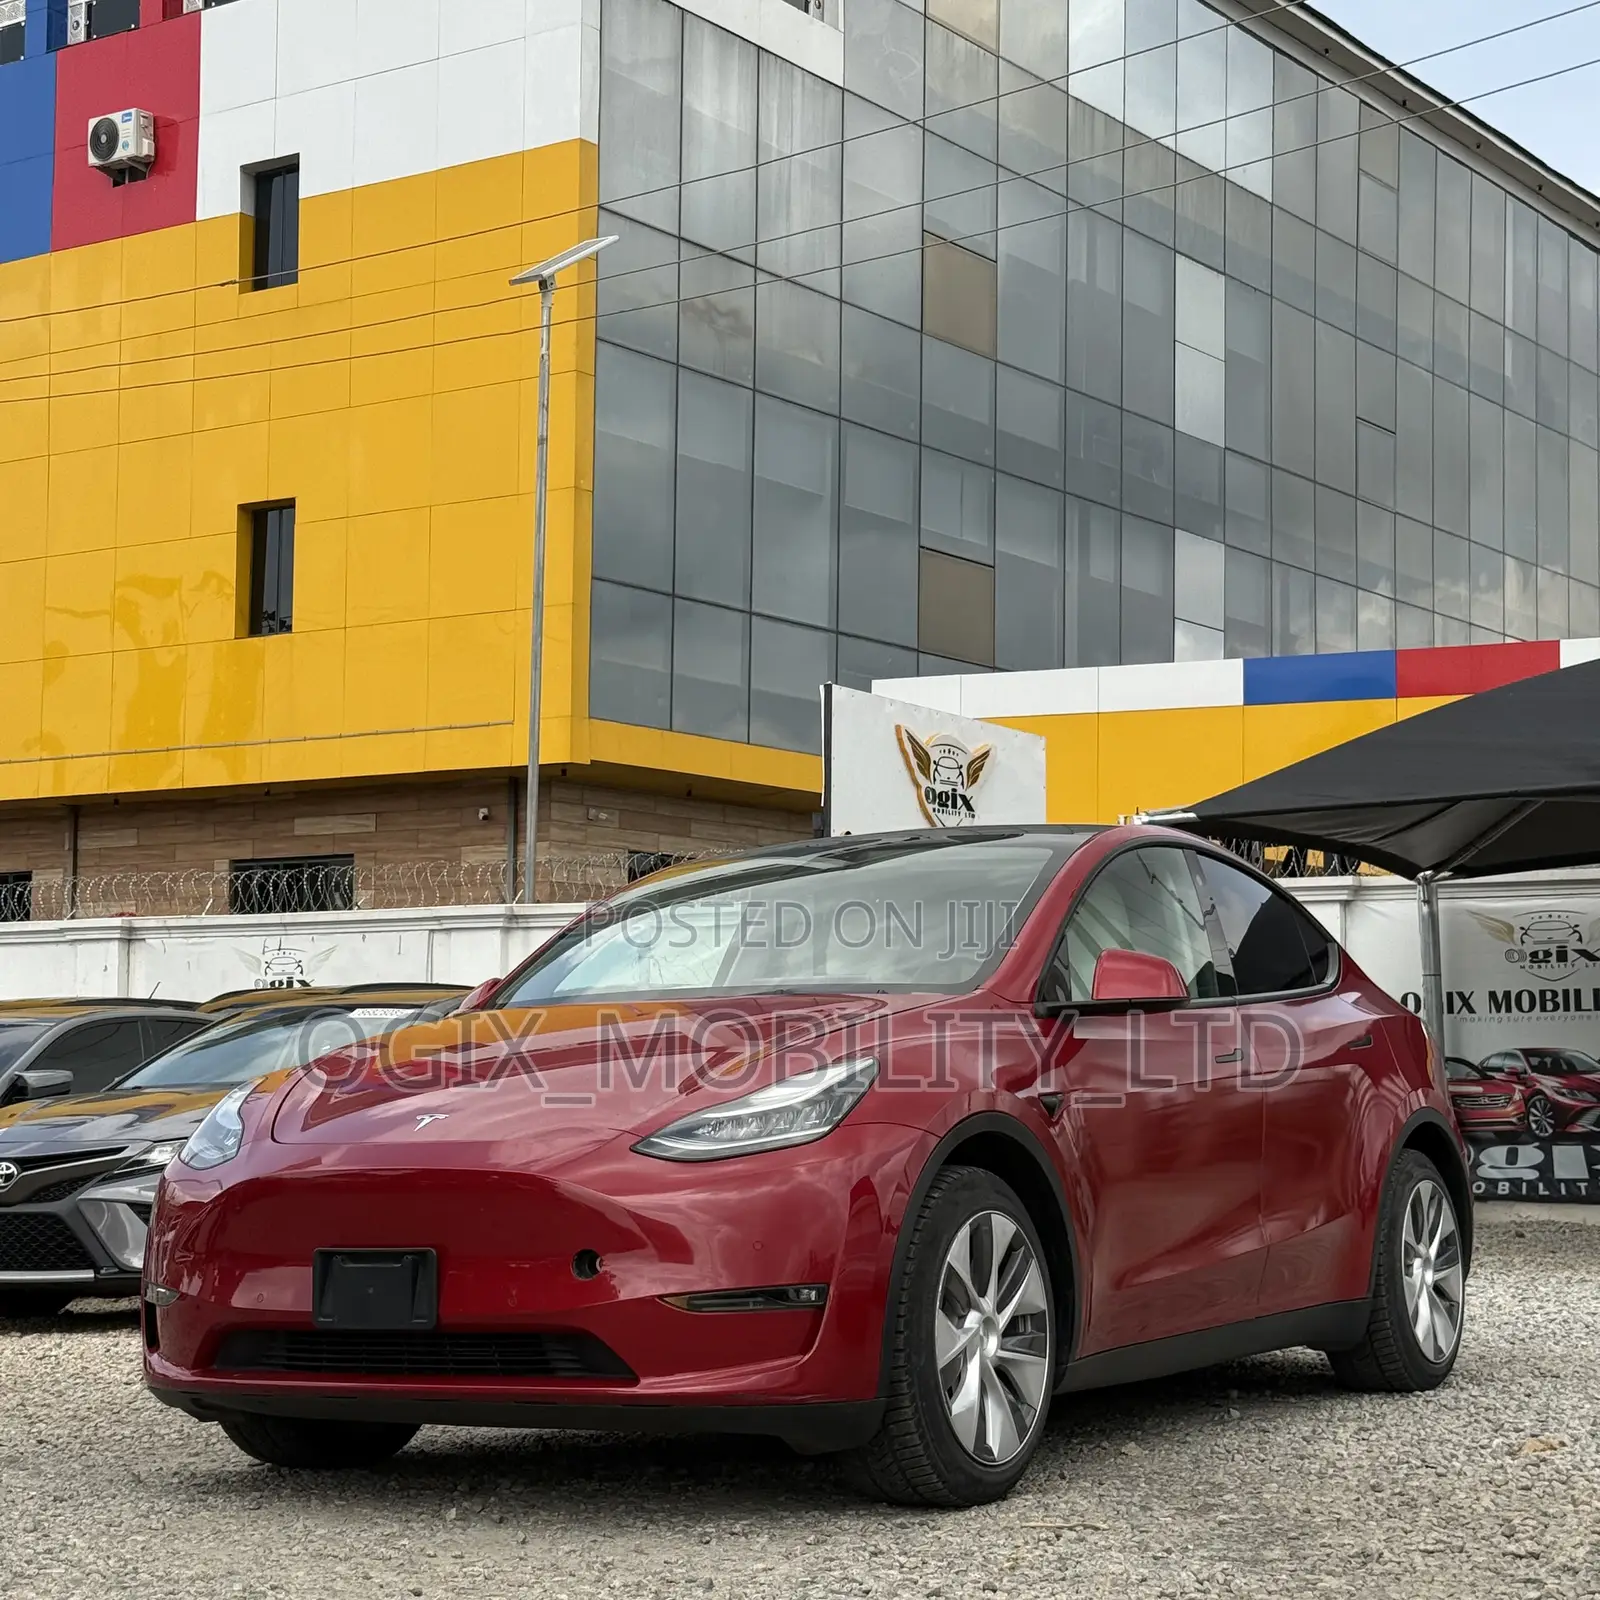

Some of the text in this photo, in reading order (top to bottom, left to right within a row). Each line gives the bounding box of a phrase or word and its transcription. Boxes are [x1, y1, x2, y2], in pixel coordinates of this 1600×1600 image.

[925, 785, 975, 812] Ogix
[932, 807, 961, 817] MOBILITY
[1401, 990, 1477, 1015] OIX
[1472, 1181, 1600, 1196] OBILIT
